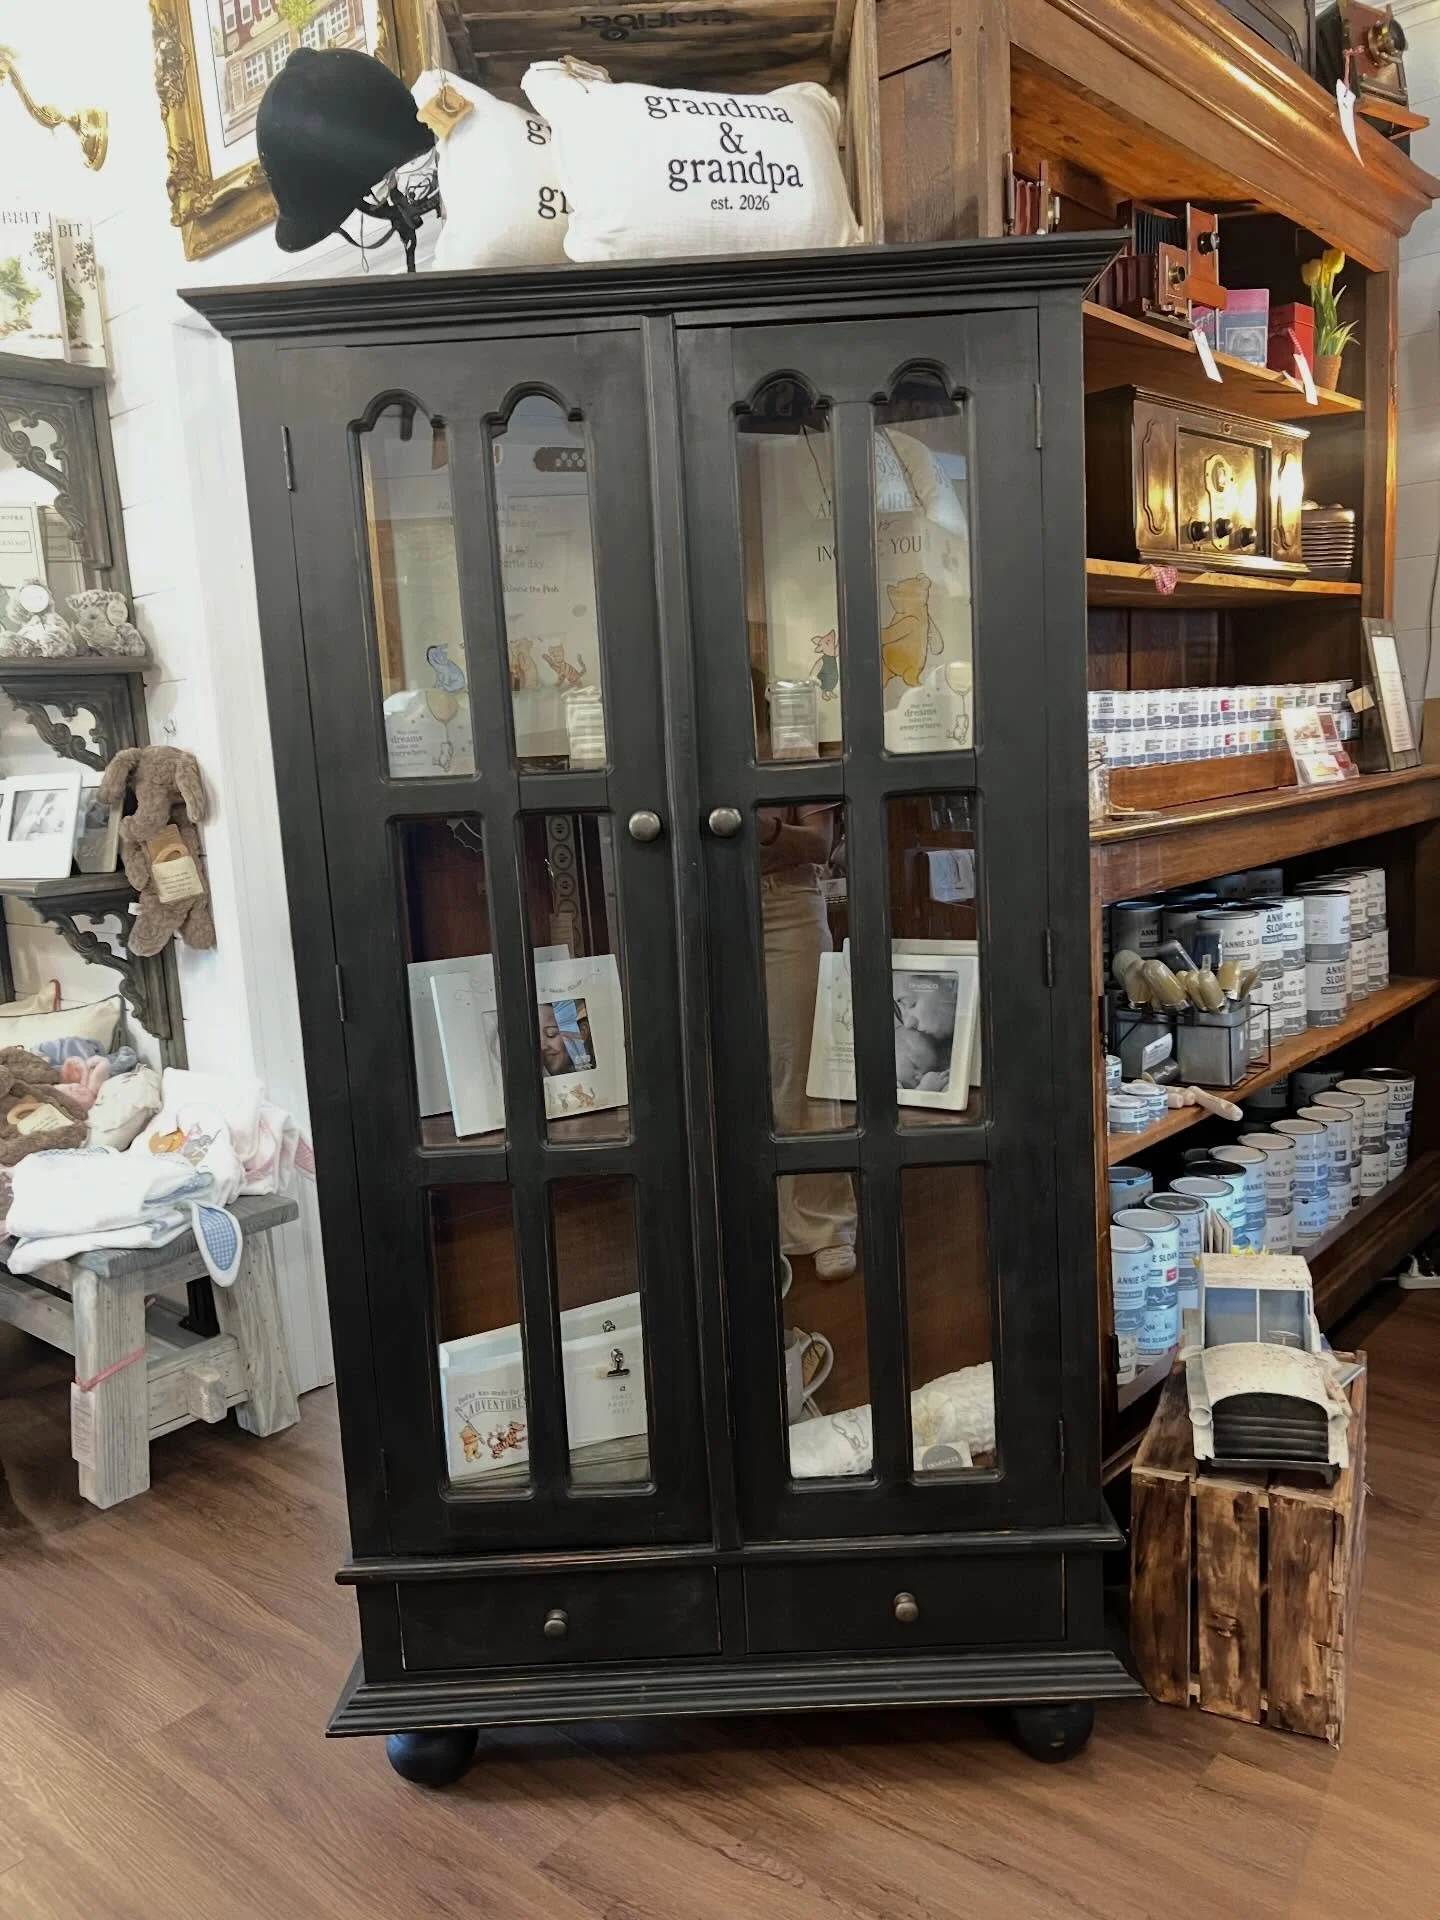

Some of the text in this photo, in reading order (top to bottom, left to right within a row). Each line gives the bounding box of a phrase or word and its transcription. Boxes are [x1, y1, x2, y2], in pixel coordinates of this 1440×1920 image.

[644, 95, 793, 124] grandma
[719, 121, 748, 154] &
[667, 150, 804, 194] grandpa
[710, 194, 770, 211] est. 2026
[58, 223, 83, 238] BIT
[890, 535, 922, 555] YOU
